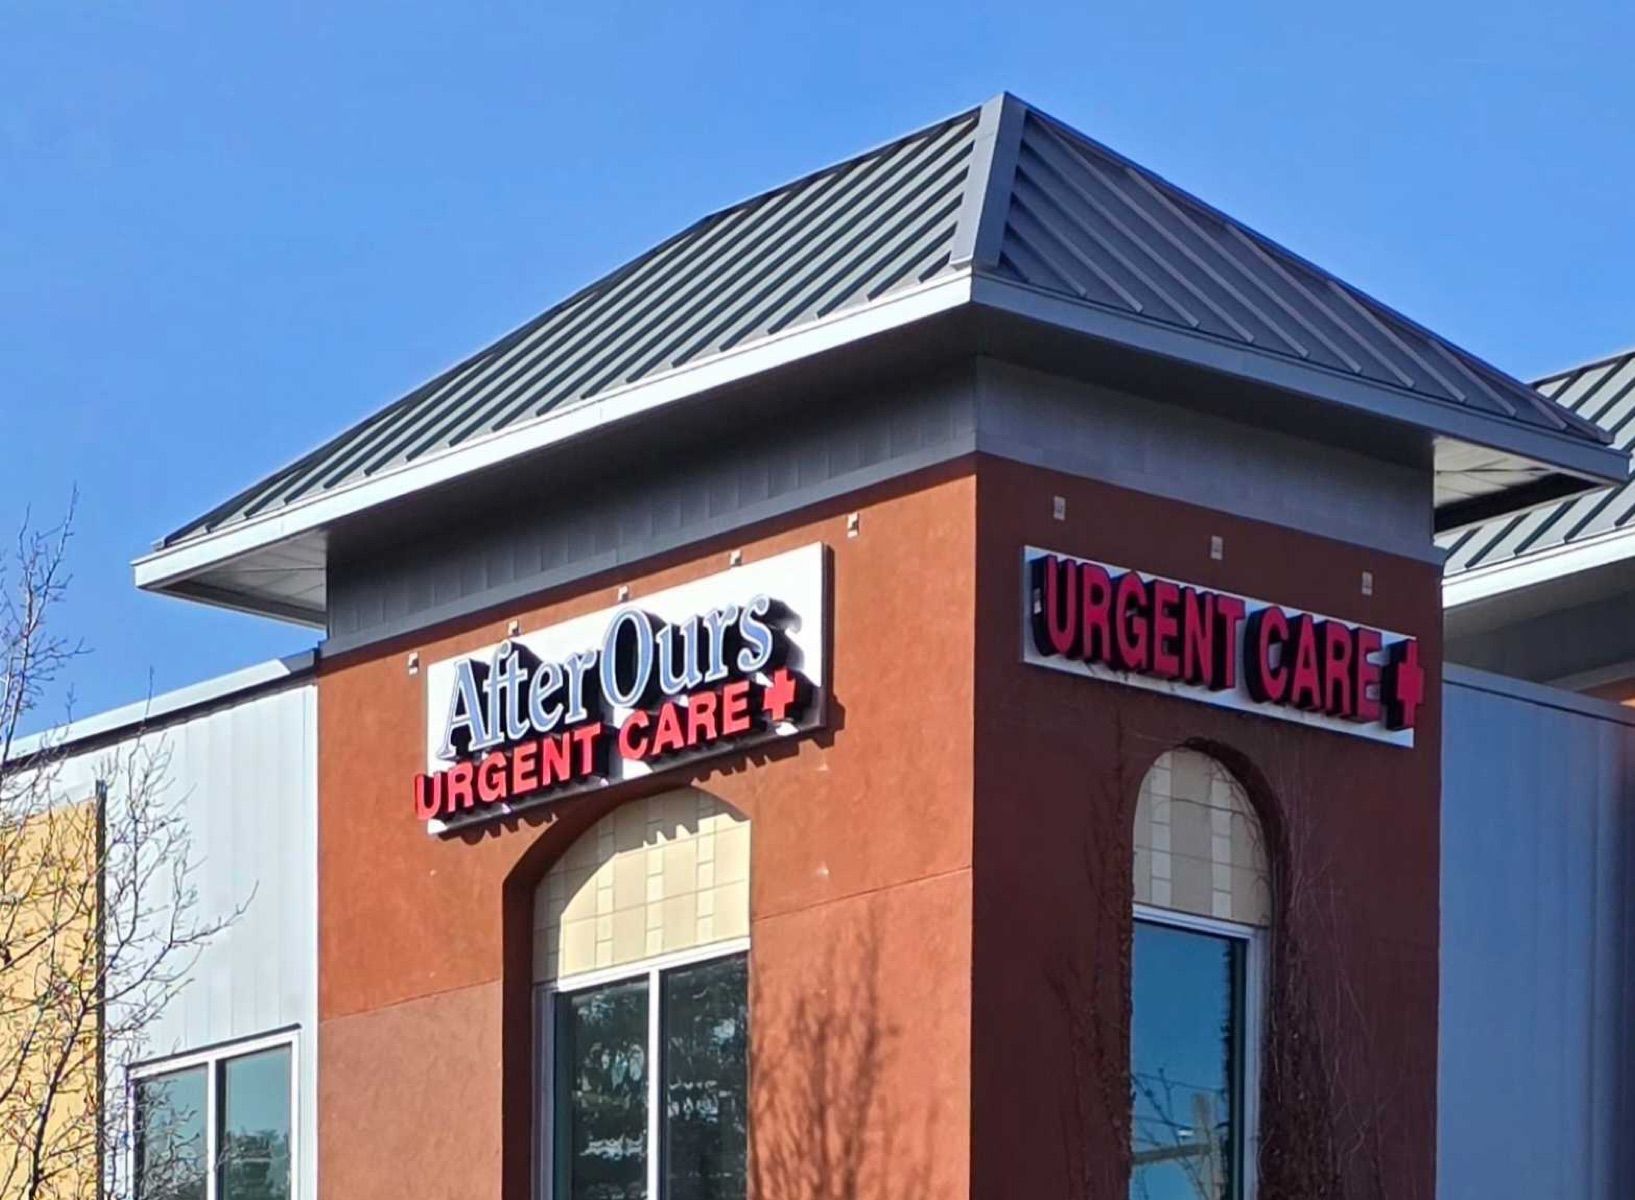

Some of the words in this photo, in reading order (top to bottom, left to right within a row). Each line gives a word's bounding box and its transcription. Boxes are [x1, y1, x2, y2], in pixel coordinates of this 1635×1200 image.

[1036, 554, 1245, 691] URGENT
[1252, 606, 1382, 722] CARE
[414, 722, 601, 820] URGENT
[617, 680, 751, 761] CARE
